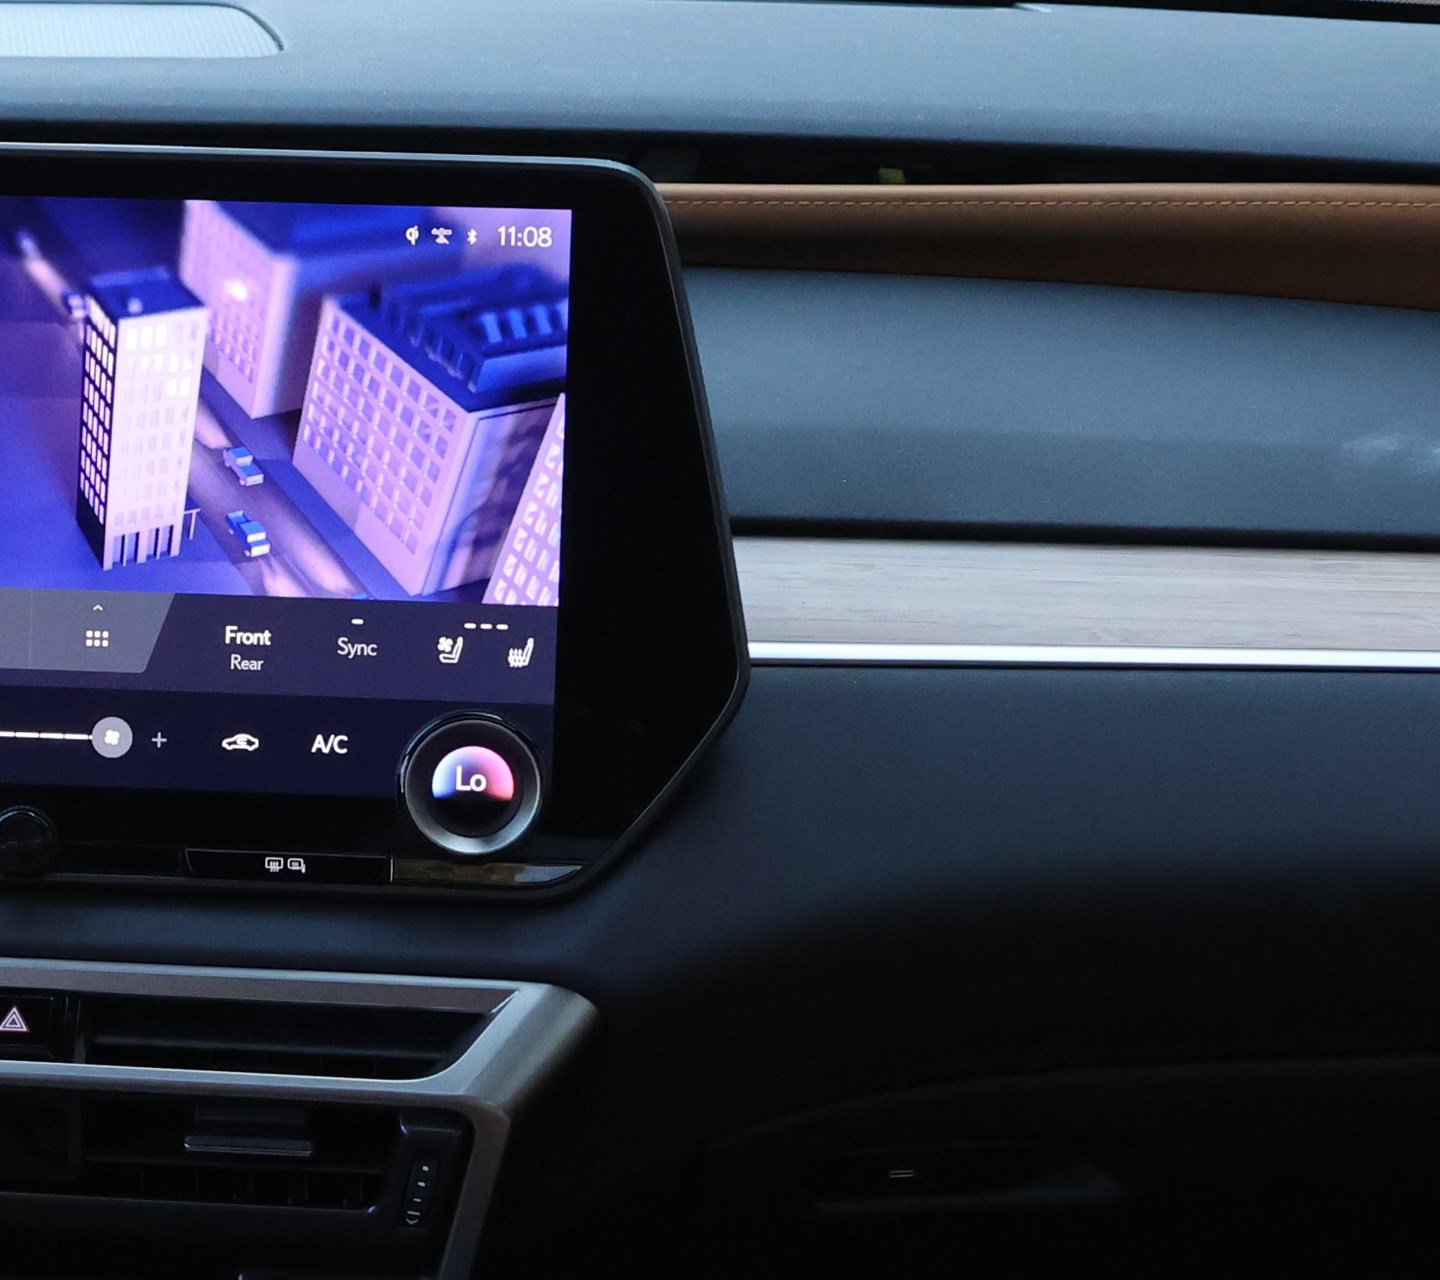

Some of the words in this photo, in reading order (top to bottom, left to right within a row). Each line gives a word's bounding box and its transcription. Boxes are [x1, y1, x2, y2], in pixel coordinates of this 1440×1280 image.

[497, 225, 553, 248] 11:08
[224, 626, 272, 647] Front
[336, 637, 378, 659] Sync
[230, 654, 264, 672] Rear
[311, 733, 349, 756] A/C
[454, 765, 487, 793] Lo
